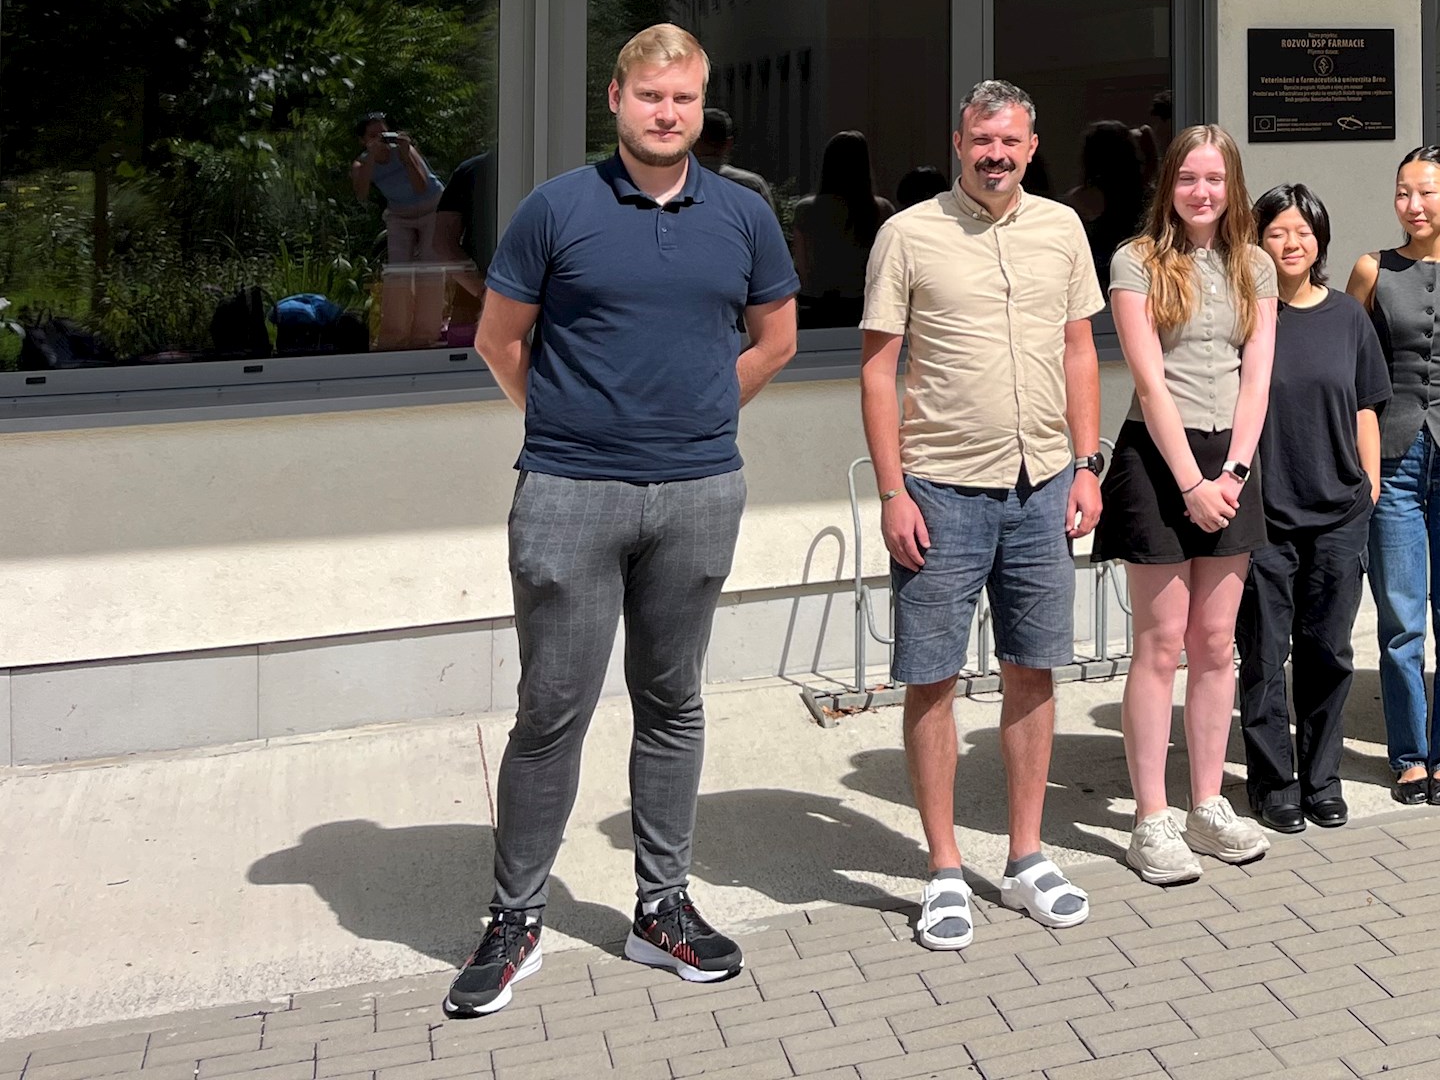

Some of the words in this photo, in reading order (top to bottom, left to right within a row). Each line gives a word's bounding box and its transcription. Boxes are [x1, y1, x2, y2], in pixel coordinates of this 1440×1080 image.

[1281, 39, 1309, 48] ROZVOJ
[1311, 39, 1326, 48] DSP
[1328, 39, 1365, 48] FARMACIE
